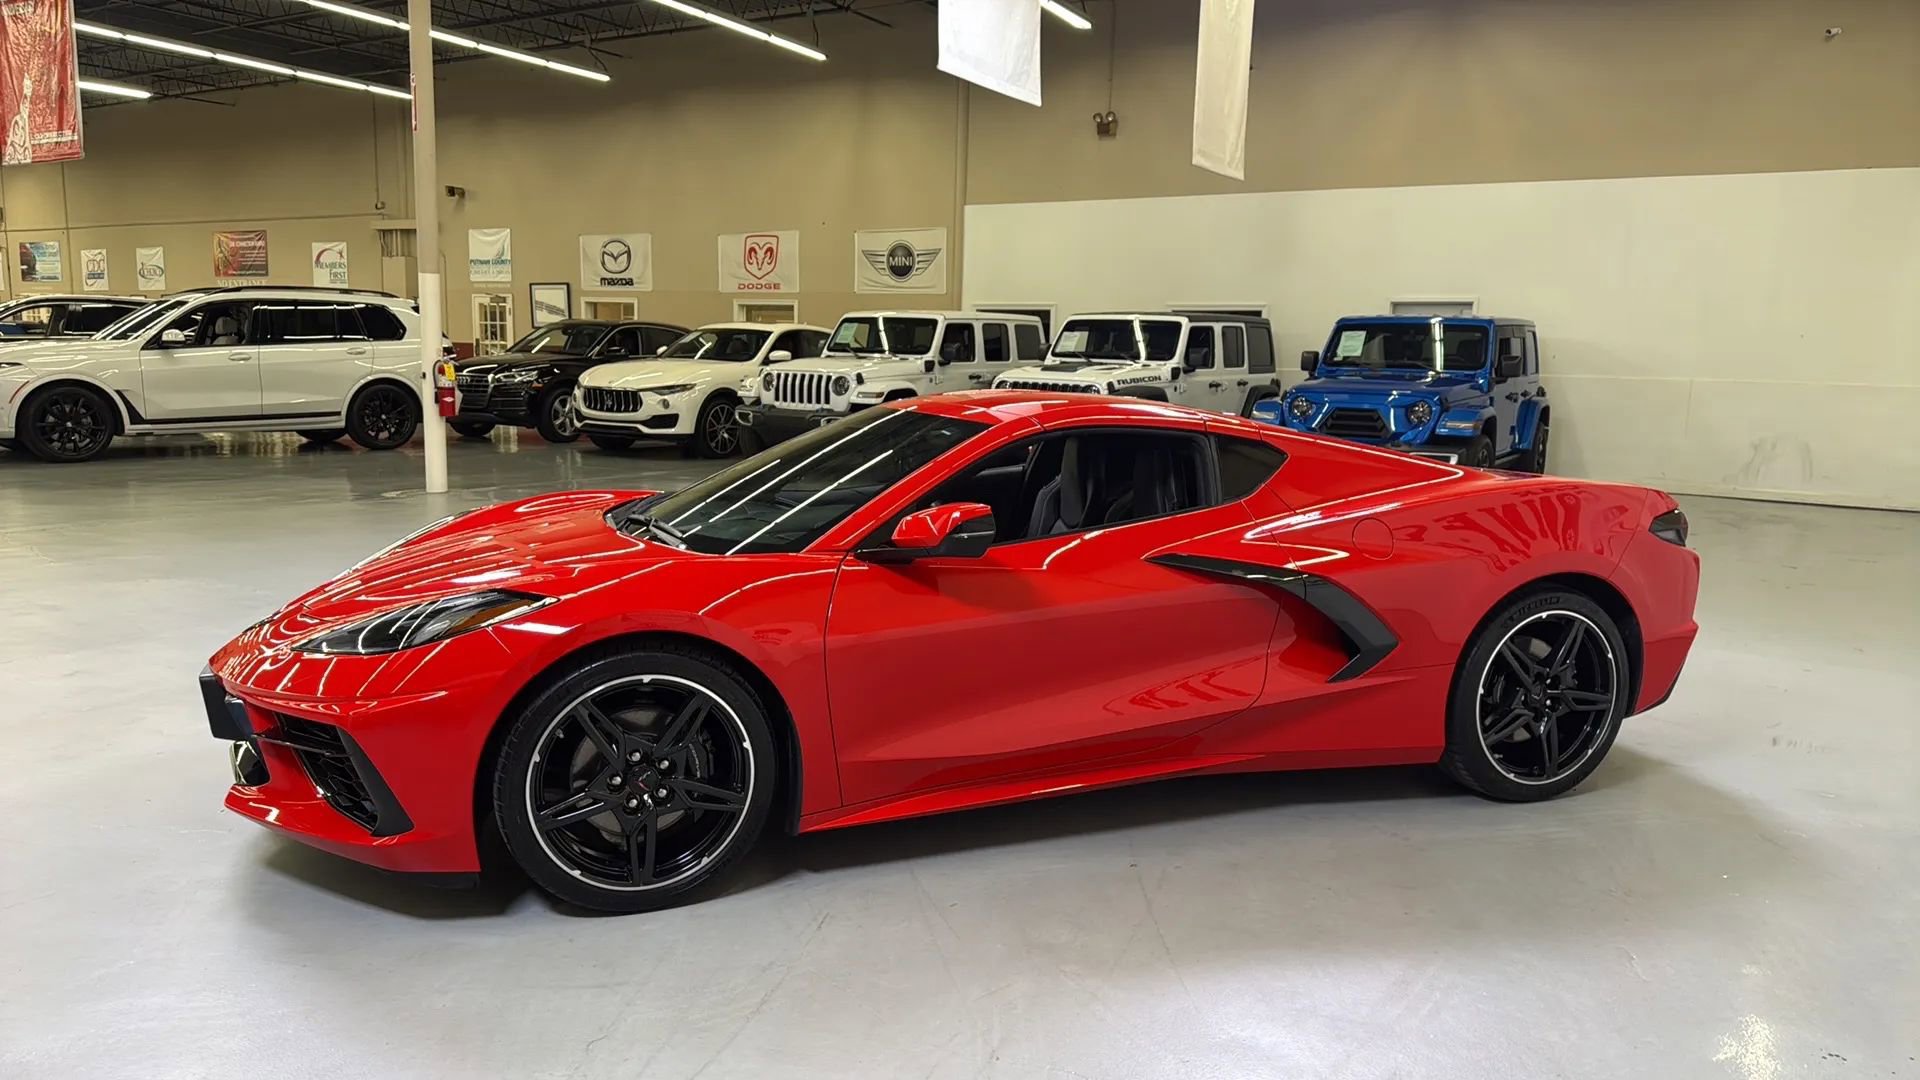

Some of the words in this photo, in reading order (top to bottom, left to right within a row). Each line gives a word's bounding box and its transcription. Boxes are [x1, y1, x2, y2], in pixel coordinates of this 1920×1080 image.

[315, 260, 347, 270] MEMBERS
[889, 256, 913, 267] MINI
[329, 269, 346, 280] FIRST
[1117, 375, 1162, 386] RUBICON
